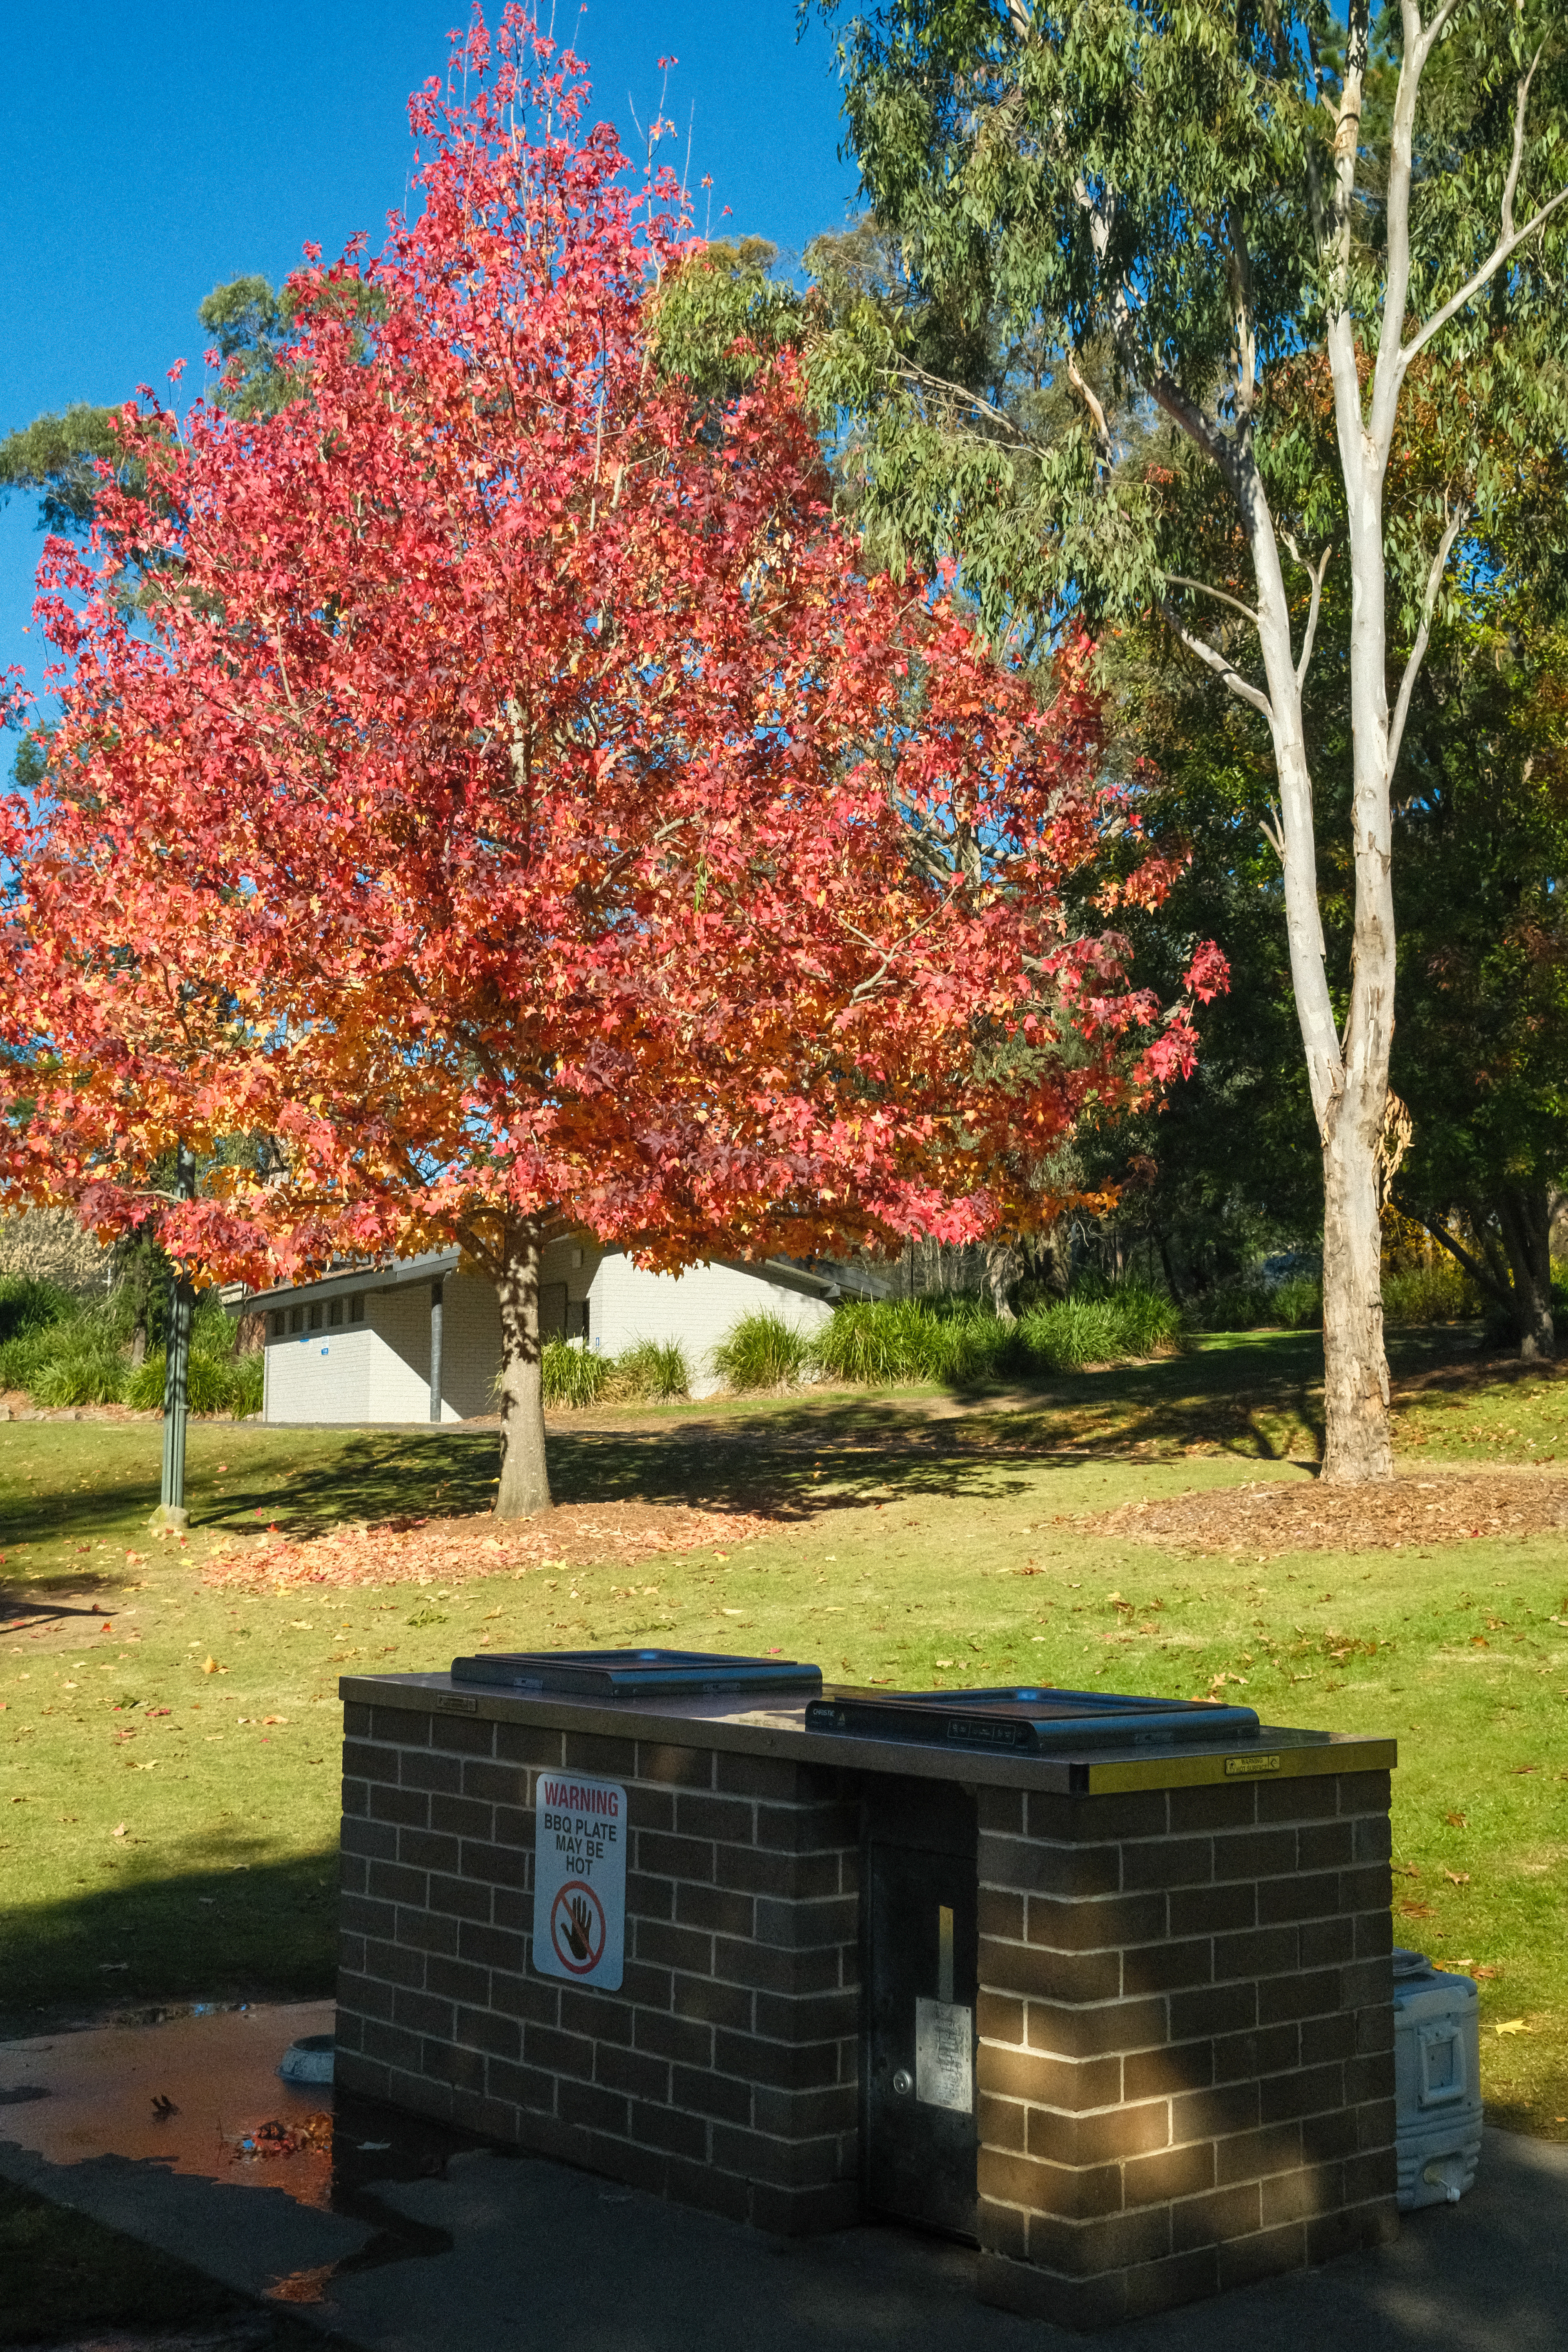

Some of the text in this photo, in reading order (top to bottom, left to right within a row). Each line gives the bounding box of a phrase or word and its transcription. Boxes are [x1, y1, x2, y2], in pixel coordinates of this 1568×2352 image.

[545, 1782, 618, 1817] WARNING
[545, 1813, 617, 1842] BBQ PLATE
[556, 1834, 604, 1858] MAY BE
[566, 1855, 593, 1875] HOT
